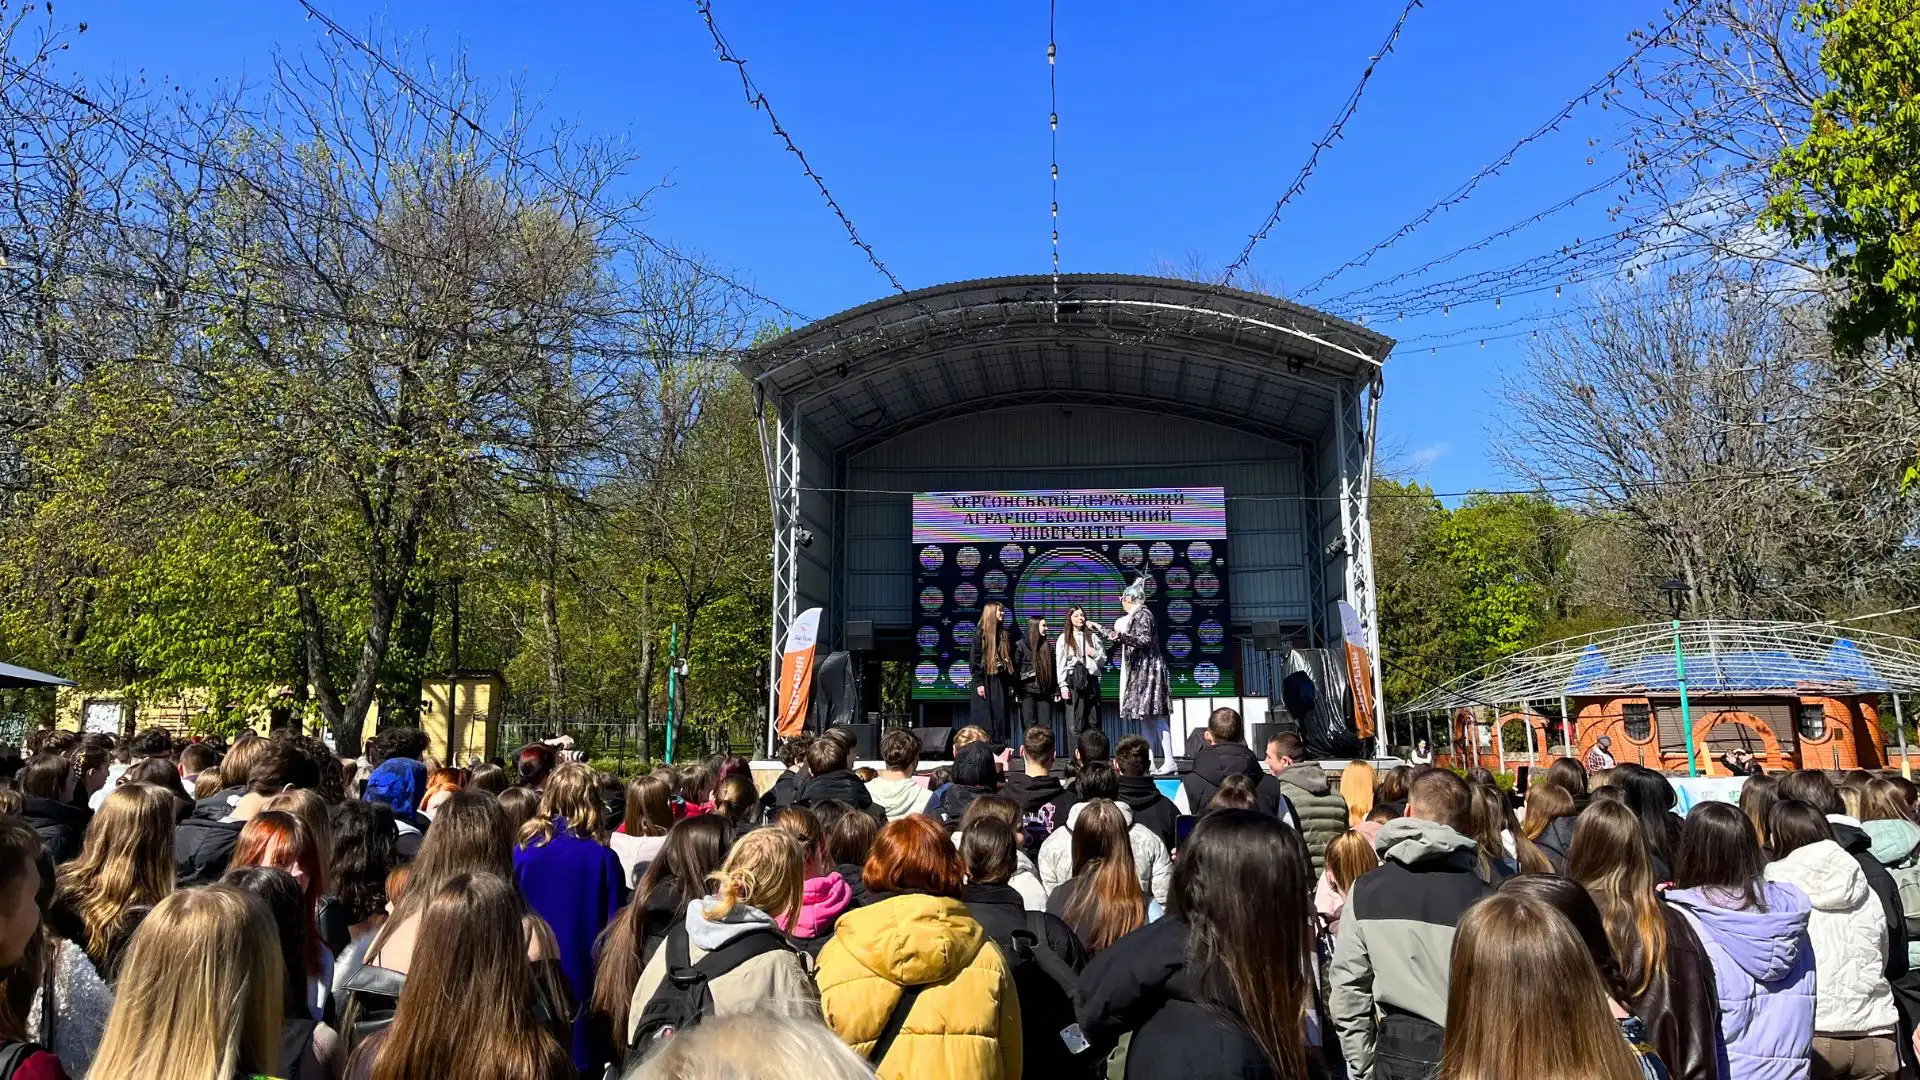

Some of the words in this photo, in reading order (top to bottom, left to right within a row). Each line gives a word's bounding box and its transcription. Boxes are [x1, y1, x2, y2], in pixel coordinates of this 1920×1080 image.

[951, 490, 1071, 508] ХЕРСОНСЬКИЙ
[1076, 488, 1184, 508] ДЕРЖАВНИЙ
[963, 506, 1172, 524] АГРАРНО-ЕКОНОМІЧНИЙ
[1010, 525, 1125, 540] УНІВЕРСИТЕТ
